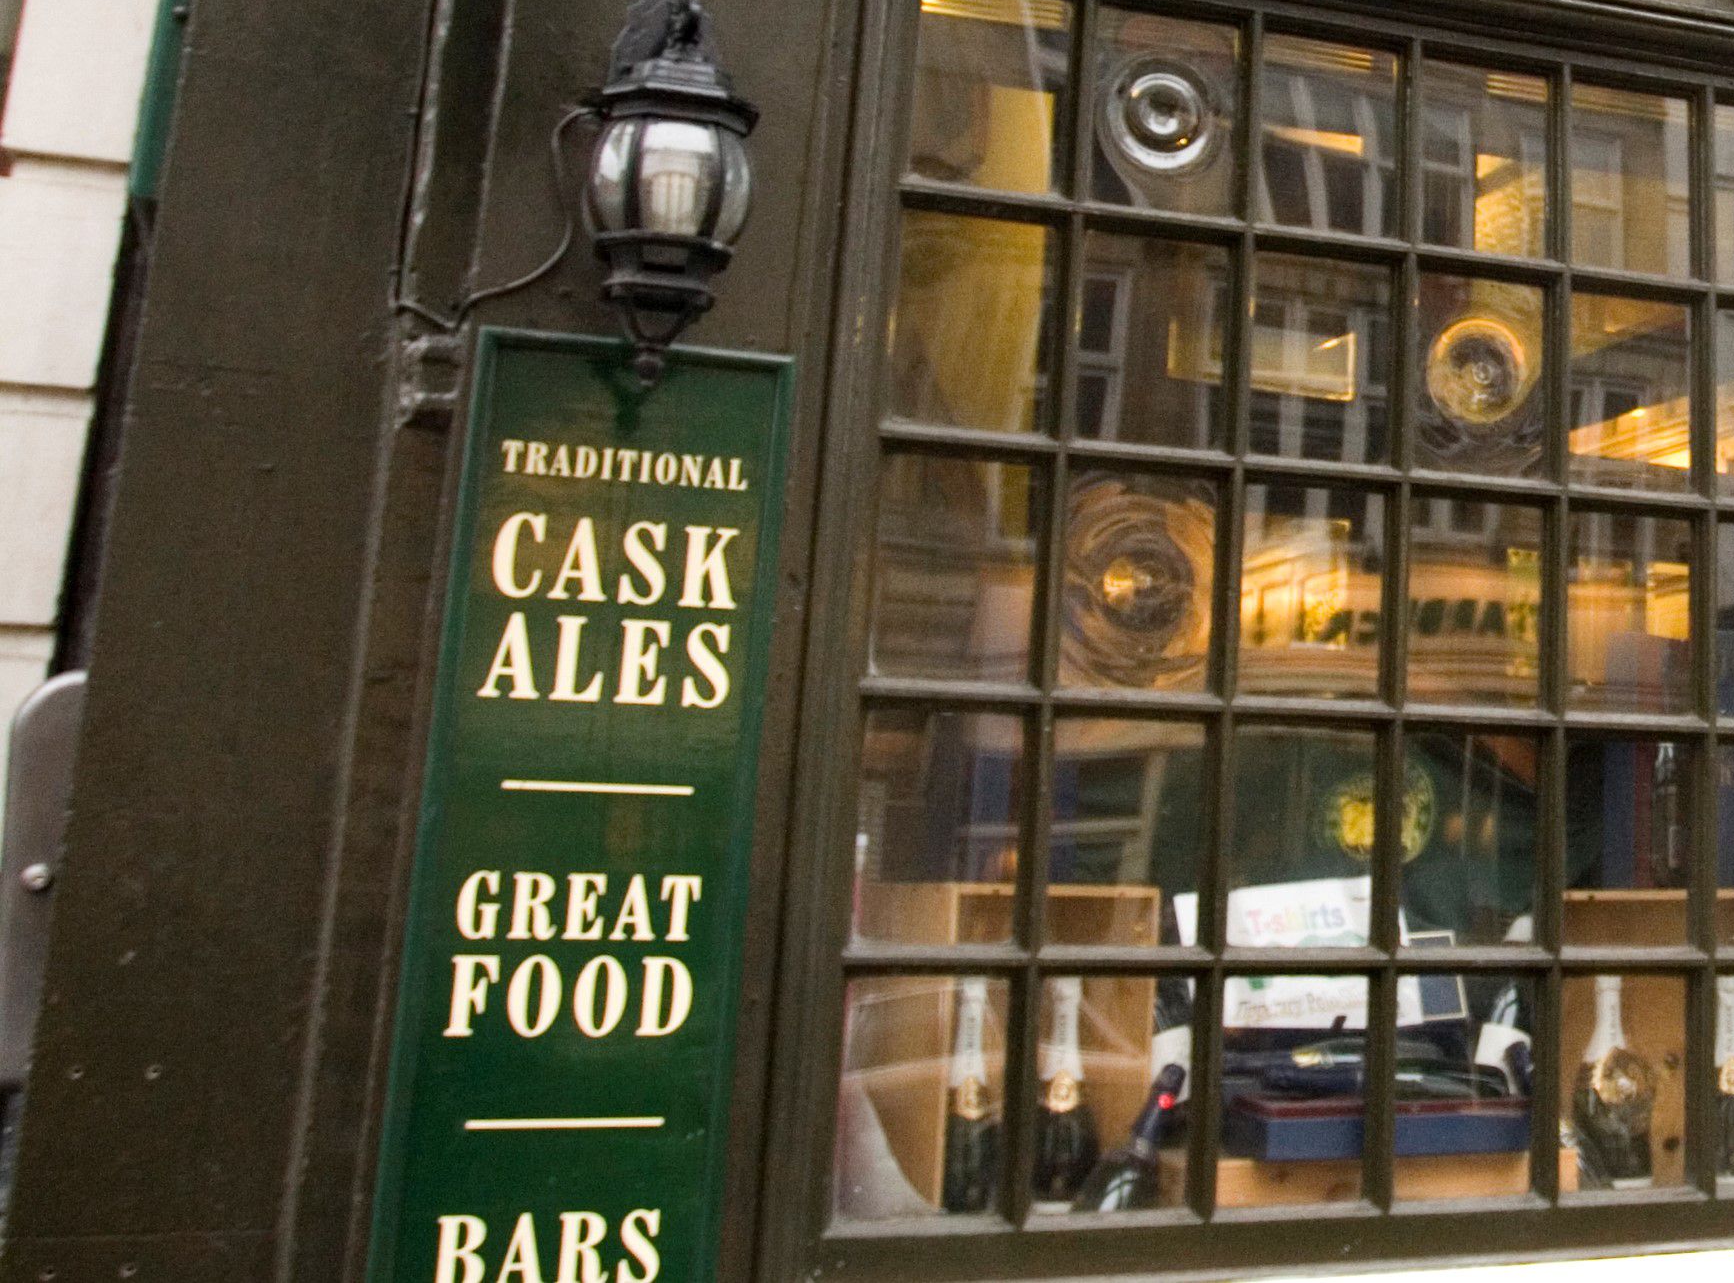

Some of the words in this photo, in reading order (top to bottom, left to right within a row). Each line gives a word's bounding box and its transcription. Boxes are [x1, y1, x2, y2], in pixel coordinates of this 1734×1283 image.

[501, 439, 749, 491] TRADITIONAL
[492, 512, 740, 611] CASK
[476, 611, 732, 709] ALES
[456, 869, 703, 942] GREAT
[1246, 902, 1346, 935] T-shirts
[442, 953, 694, 1039] FOOD
[433, 1207, 662, 1283] BARS
